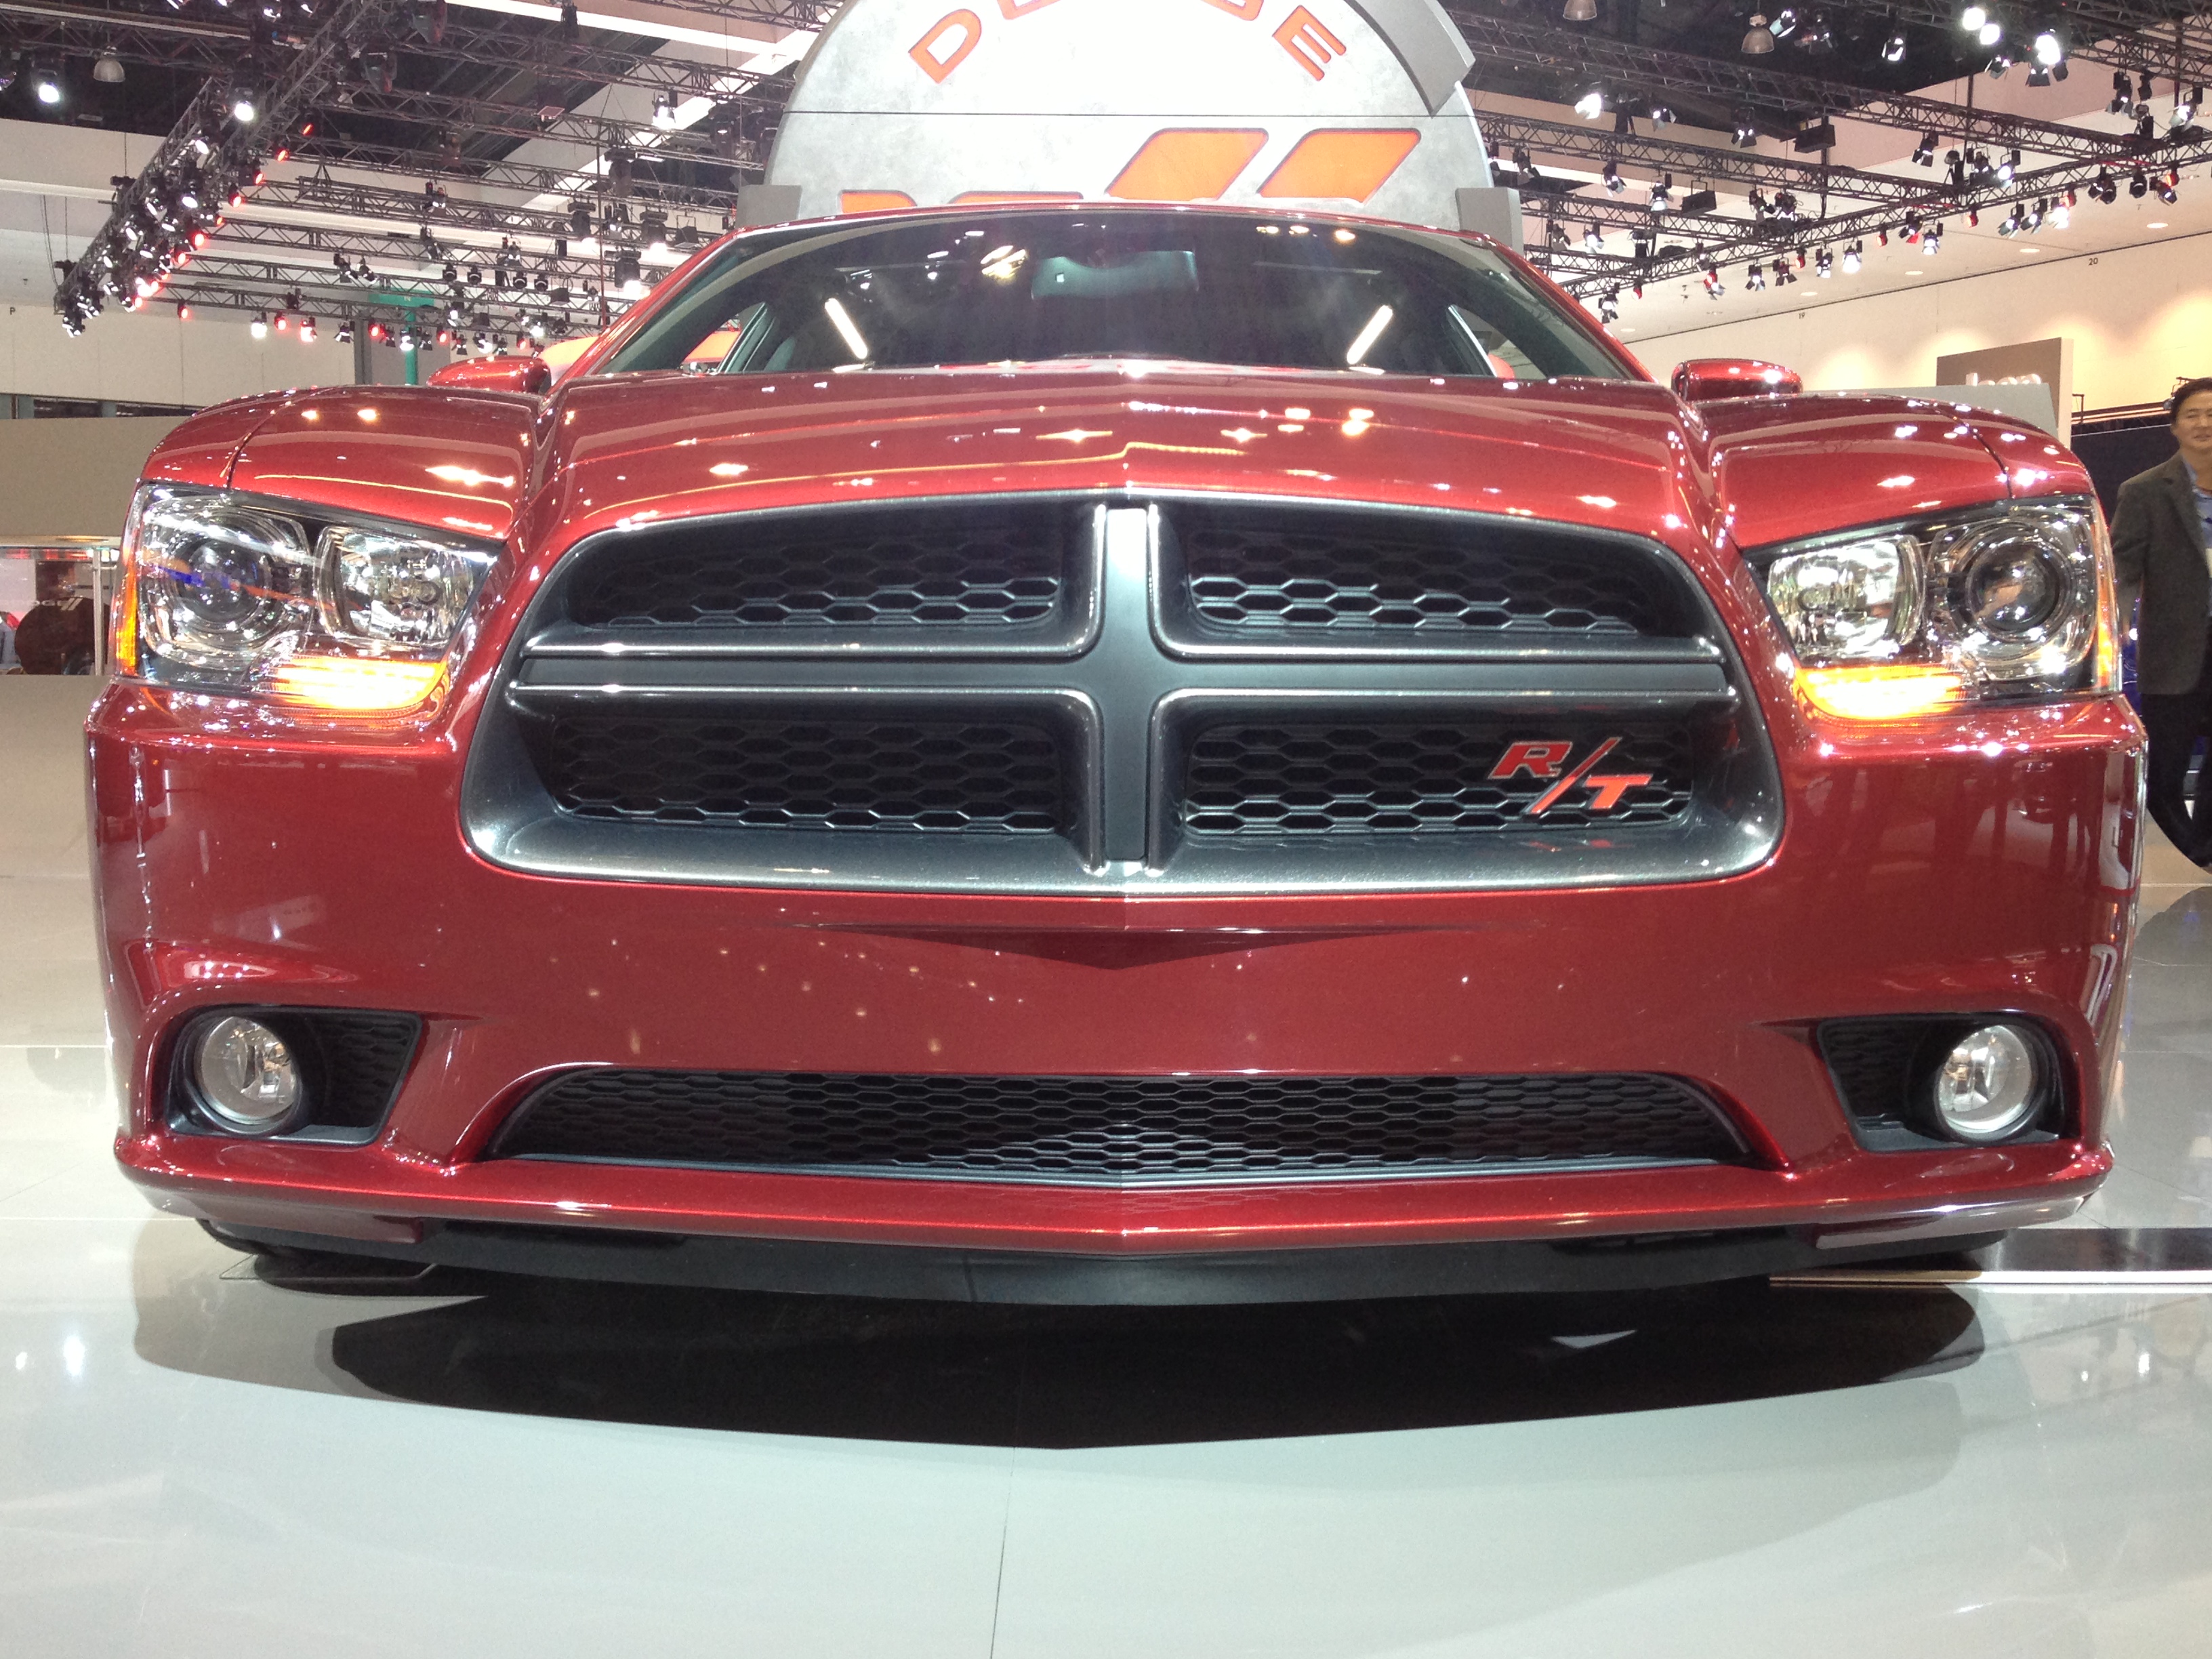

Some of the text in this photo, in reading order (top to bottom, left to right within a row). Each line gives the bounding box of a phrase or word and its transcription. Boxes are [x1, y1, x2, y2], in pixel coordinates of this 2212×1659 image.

[2088, 258, 2099, 266] 20
[9, 307, 16, 315] P
[1488, 736, 1654, 815] R/T
